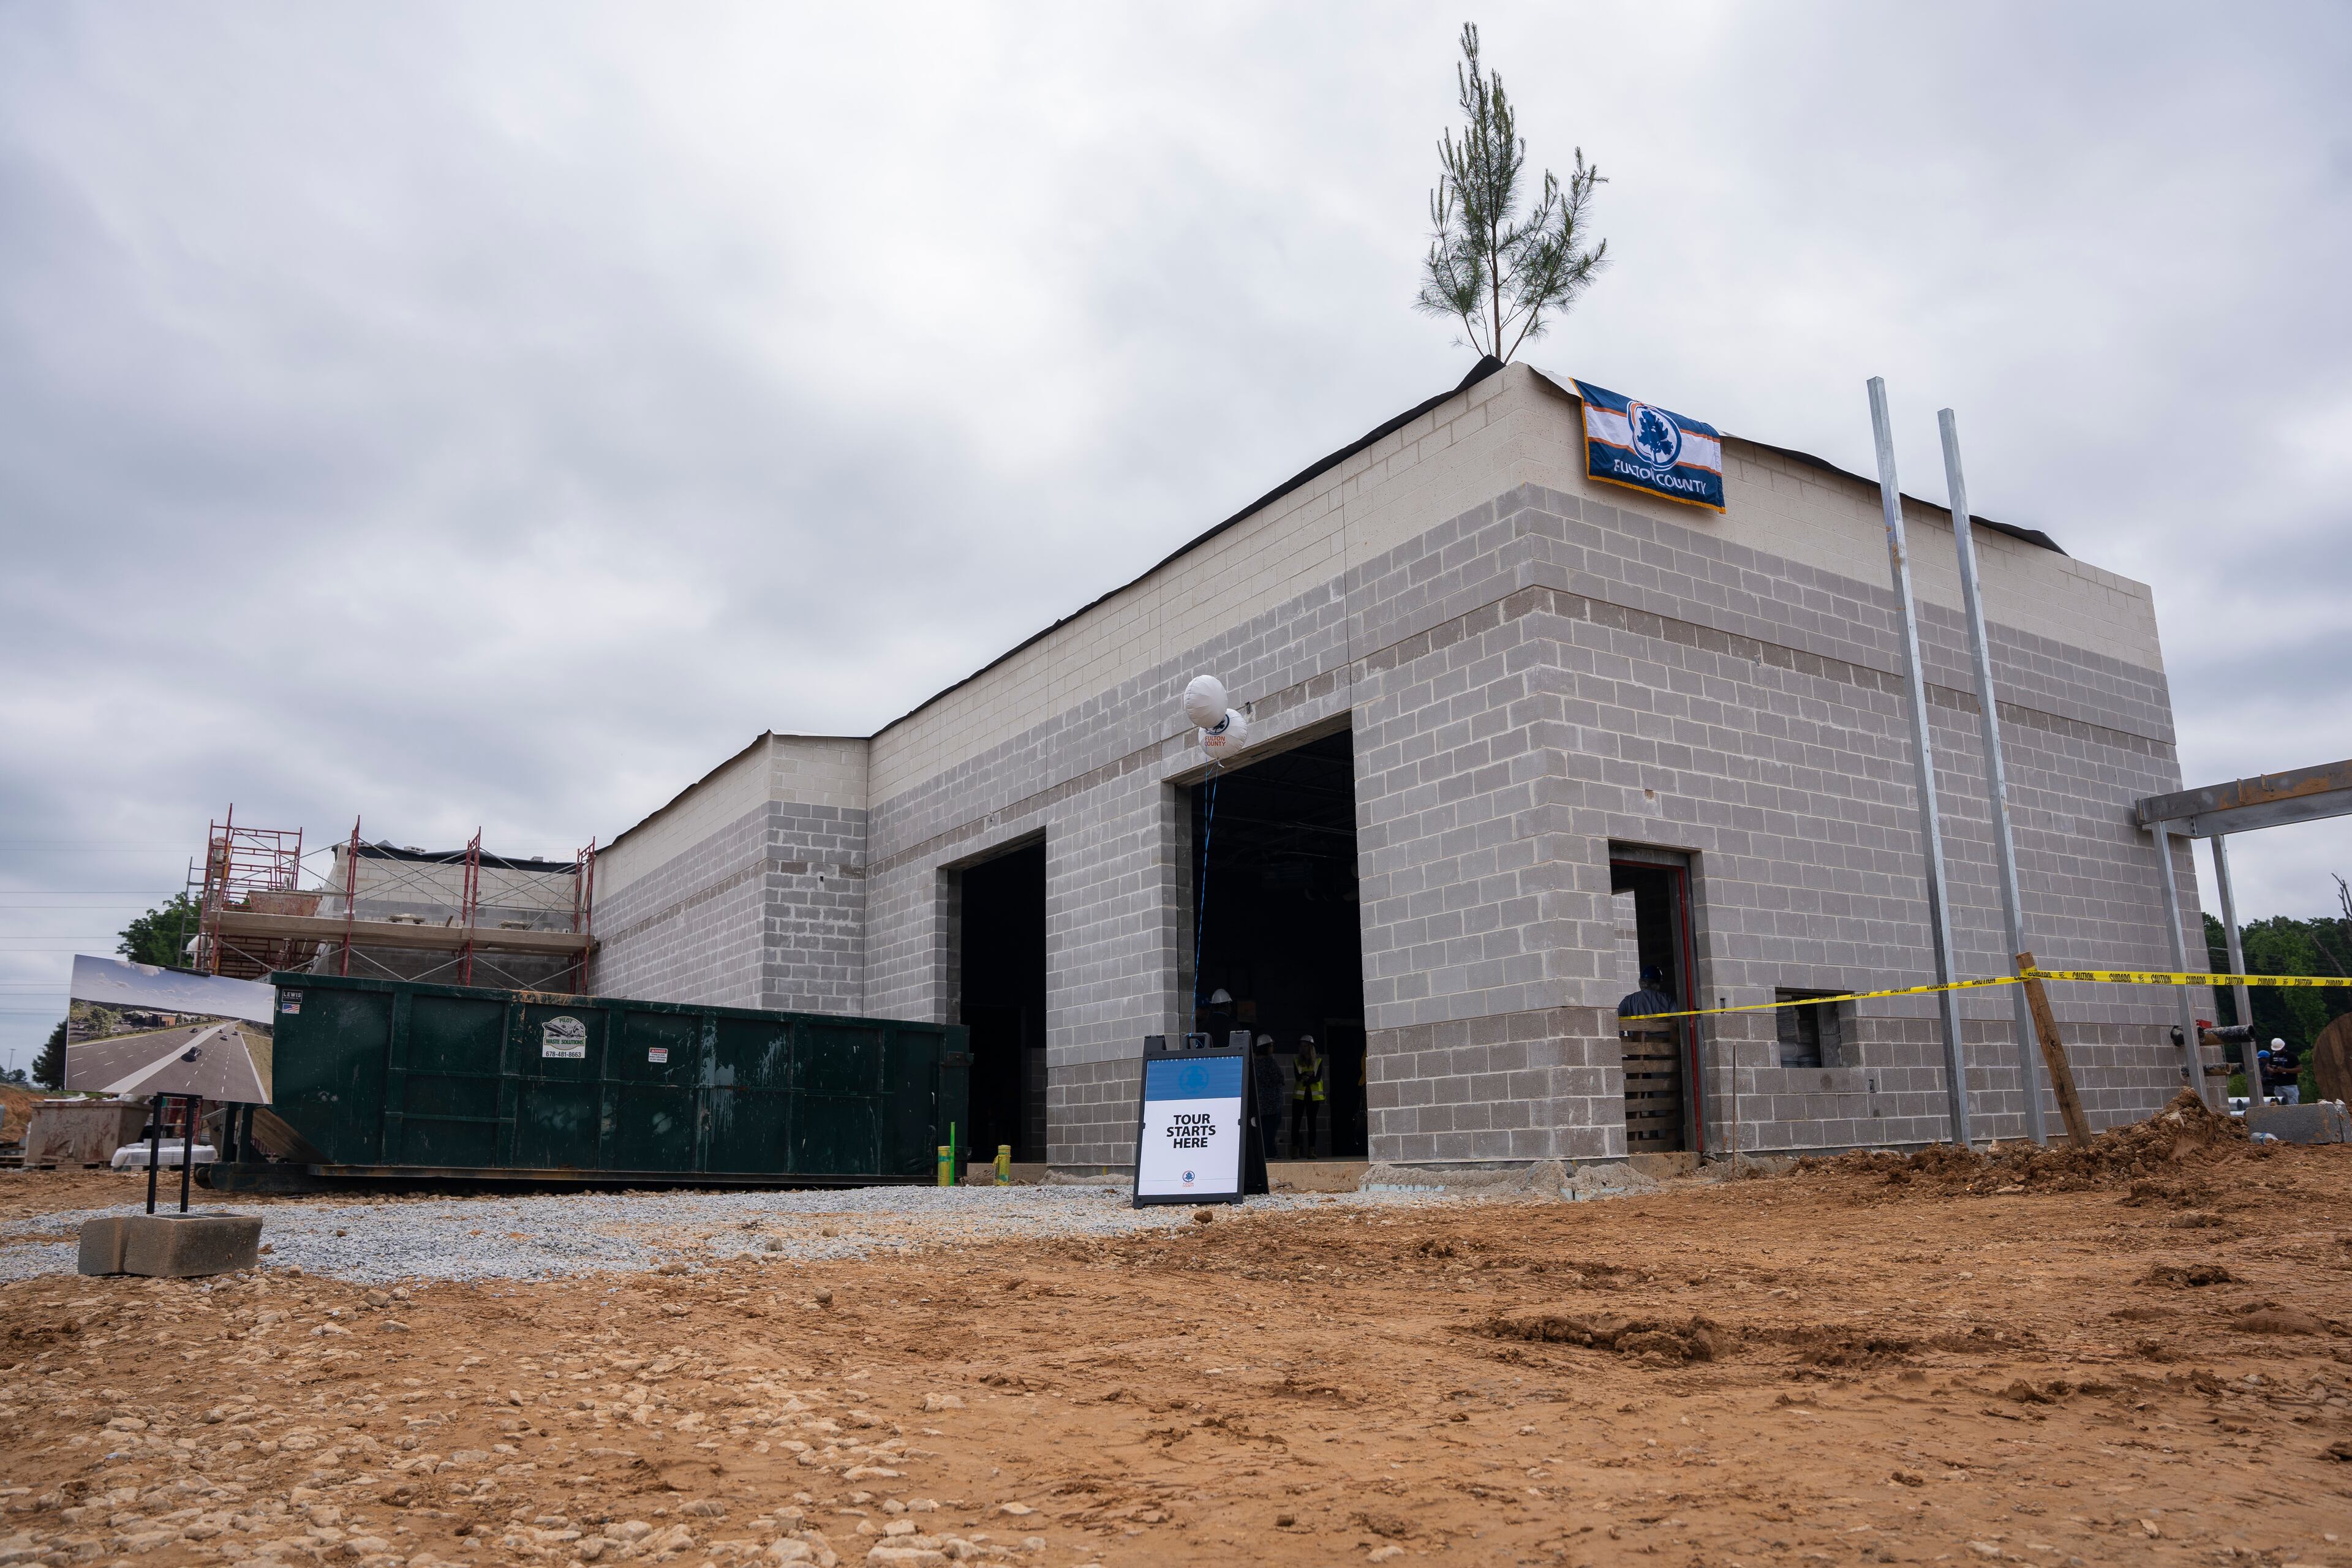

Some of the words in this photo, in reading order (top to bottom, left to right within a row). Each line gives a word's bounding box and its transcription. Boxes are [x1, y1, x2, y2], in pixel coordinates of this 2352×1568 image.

[1656, 473, 1706, 494] COUNTY
[2150, 974, 2172, 984] CAUTION
[2225, 976, 2244, 986] CAUTION
[1174, 1114, 1210, 1125] TOUR
[1166, 1125, 1216, 1137] STARTS
[1173, 1137, 1208, 1148] HERE
